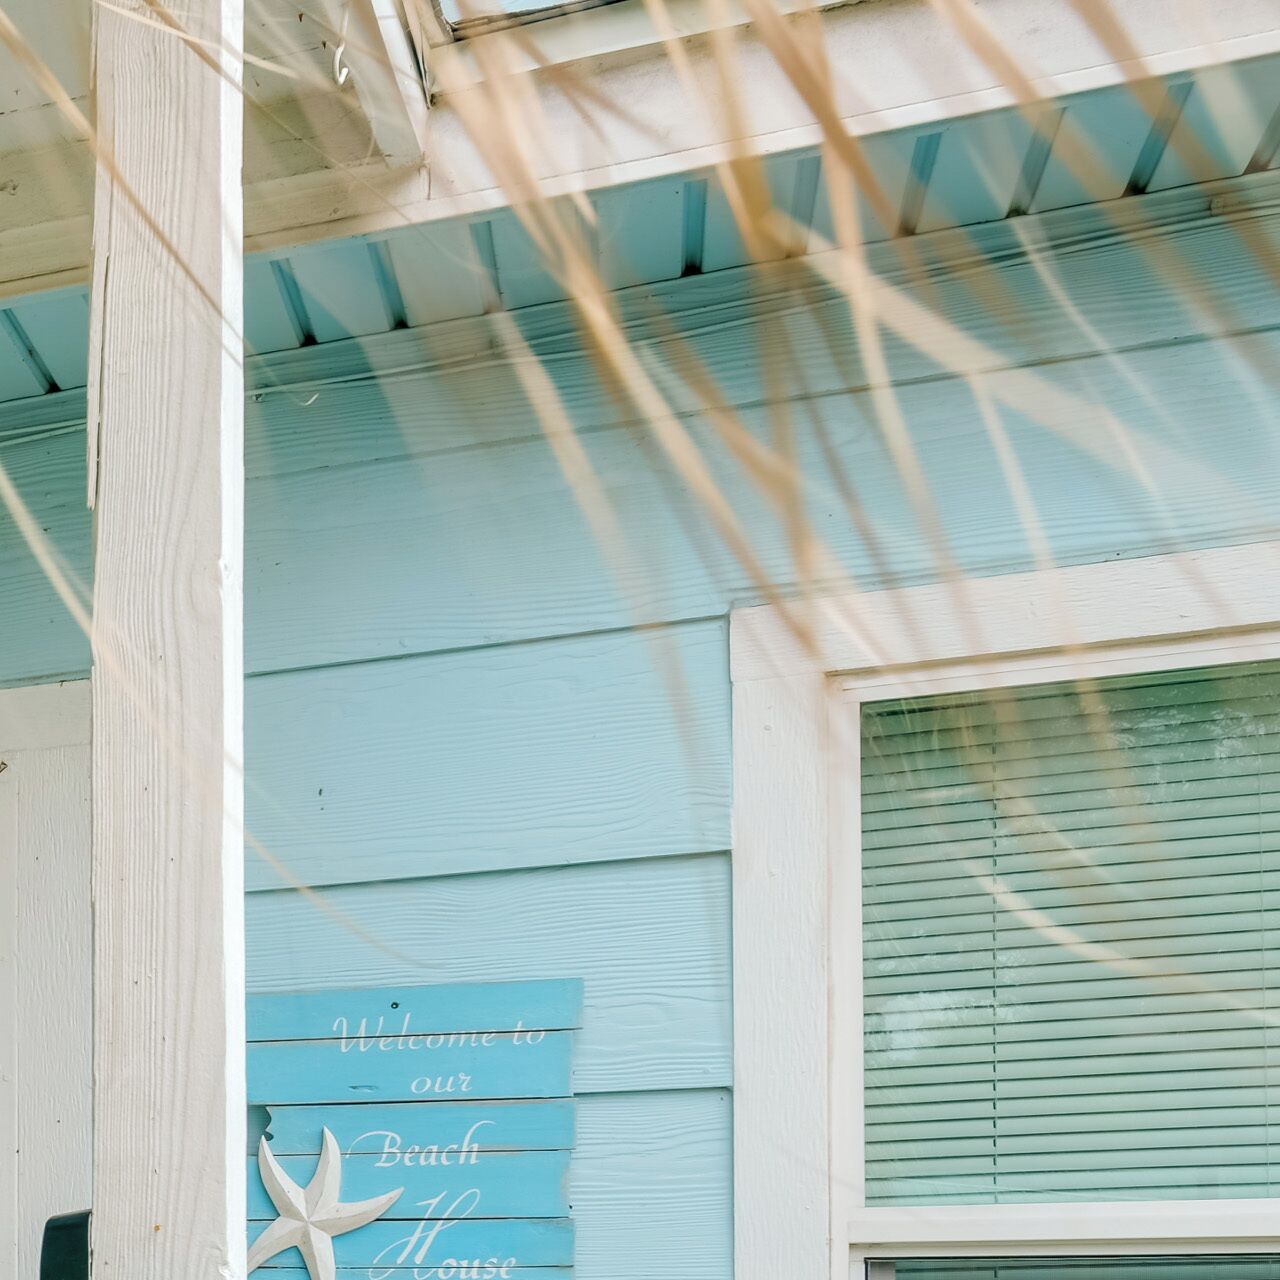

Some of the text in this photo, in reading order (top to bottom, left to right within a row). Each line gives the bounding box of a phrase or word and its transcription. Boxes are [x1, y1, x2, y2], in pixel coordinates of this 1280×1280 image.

[332, 1012, 546, 1053] Welcome to
[410, 1072, 473, 1094] our
[345, 1120, 497, 1168] Beach
[368, 1188, 517, 1280] House
